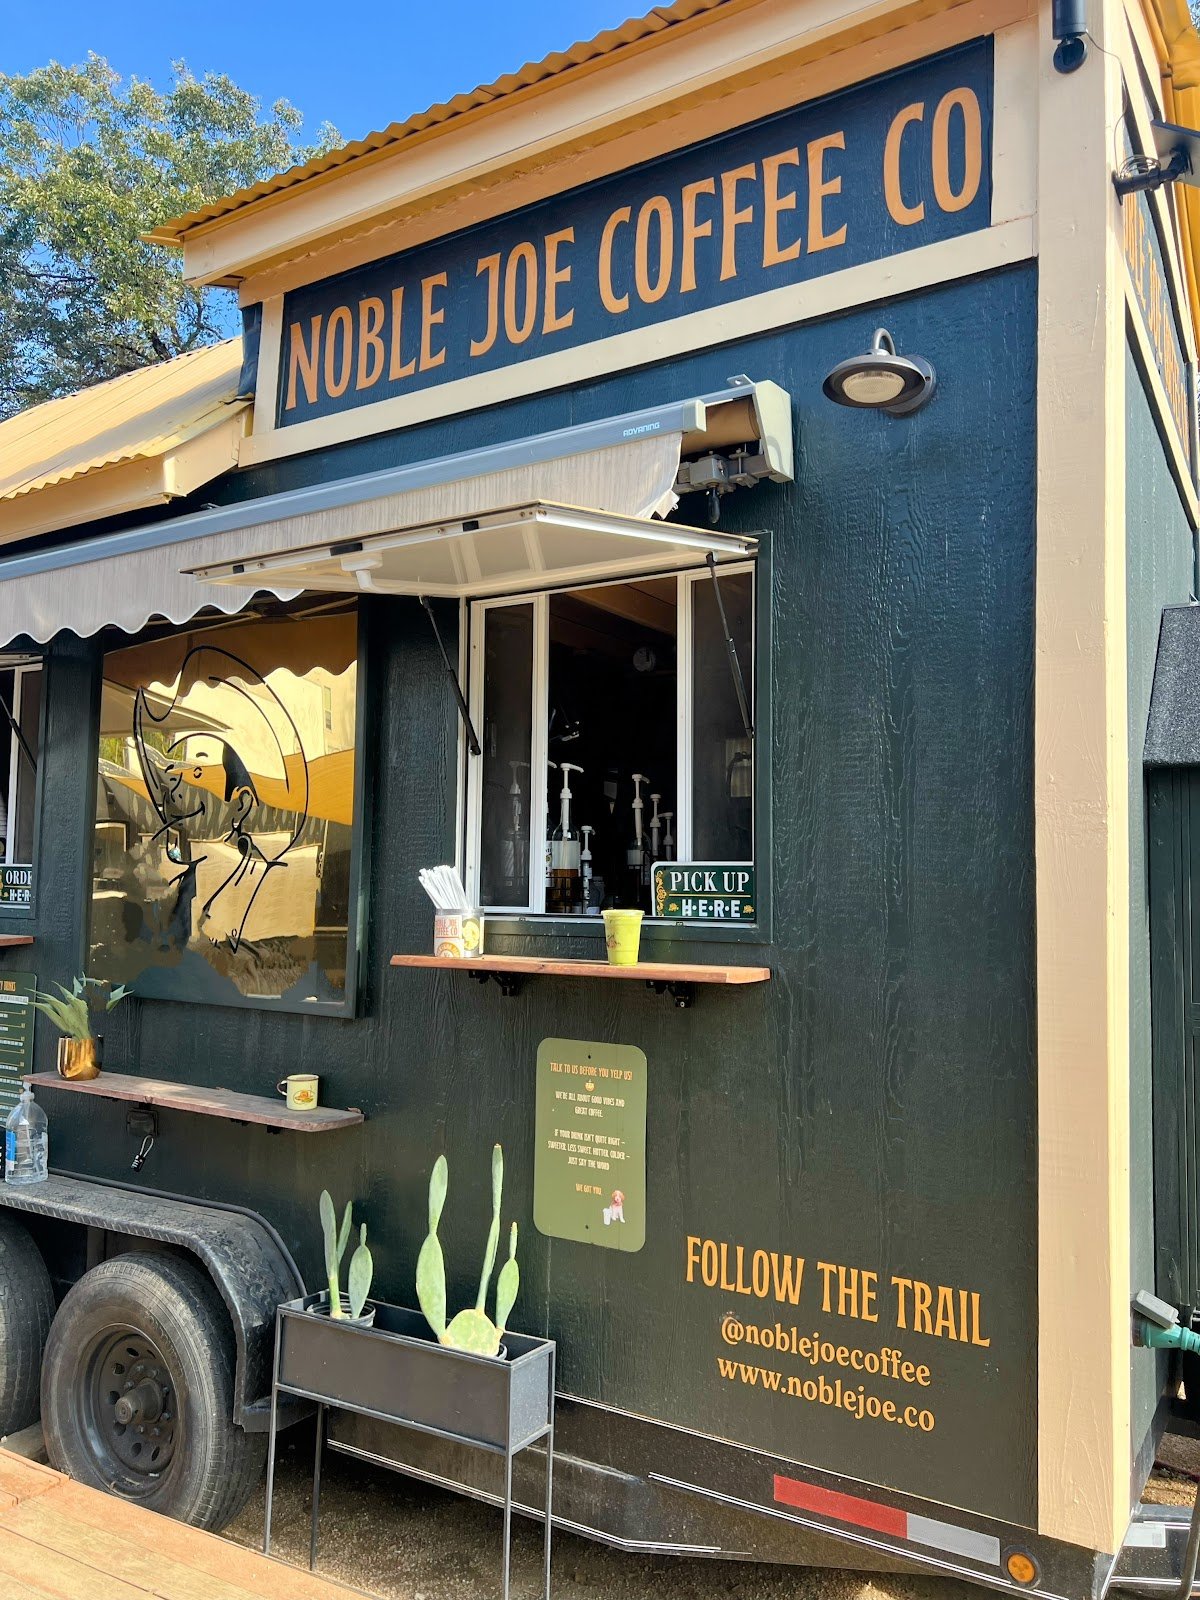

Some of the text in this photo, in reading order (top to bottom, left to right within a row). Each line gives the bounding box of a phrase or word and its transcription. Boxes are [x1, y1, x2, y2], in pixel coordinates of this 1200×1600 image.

[285, 87, 982, 411] NOBLE JOE COFFEE CO
[623, 422, 660, 437] ADVANING
[5, 870, 32, 885] ORDE
[670, 871, 750, 892] PICK UP
[550, 1062, 562, 1072] TALK
[564, 1064, 570, 1073] TO
[572, 1065, 578, 1075] US
[580, 1066, 597, 1077] BEFORE
[599, 1068, 609, 1078] YOU
[610, 1069, 622, 1079] YELP
[568, 1092, 576, 1101] ALL
[577, 1093, 590, 1103] ABOUT
[591, 1095, 602, 1104] GOOD
[603, 1097, 614, 1106] VIBES
[615, 1098, 625, 1108] AND
[574, 1106, 588, 1115] GREAT
[554, 1128, 558, 1136] IF
[559, 1129, 570, 1139] YOUR
[571, 1131, 583, 1141] DRINK
[595, 1134, 607, 1144] QUITE
[607, 1136, 620, 1147] RIGHT
[567, 1143, 577, 1152] LESS
[610, 1150, 625, 1160] COLDER
[568, 1156, 577, 1166] JUST
[578, 1158, 587, 1167] SAY
[587, 1159, 596, 1169] THE
[575, 1183, 583, 1192] WE
[583, 1185, 592, 1194] GOT
[686, 1235, 991, 1348] FOLLOW THE TRAIL
[721, 1316, 931, 1387] @noblejoecoffee
[717, 1357, 936, 1432] www.noblejoe.co
